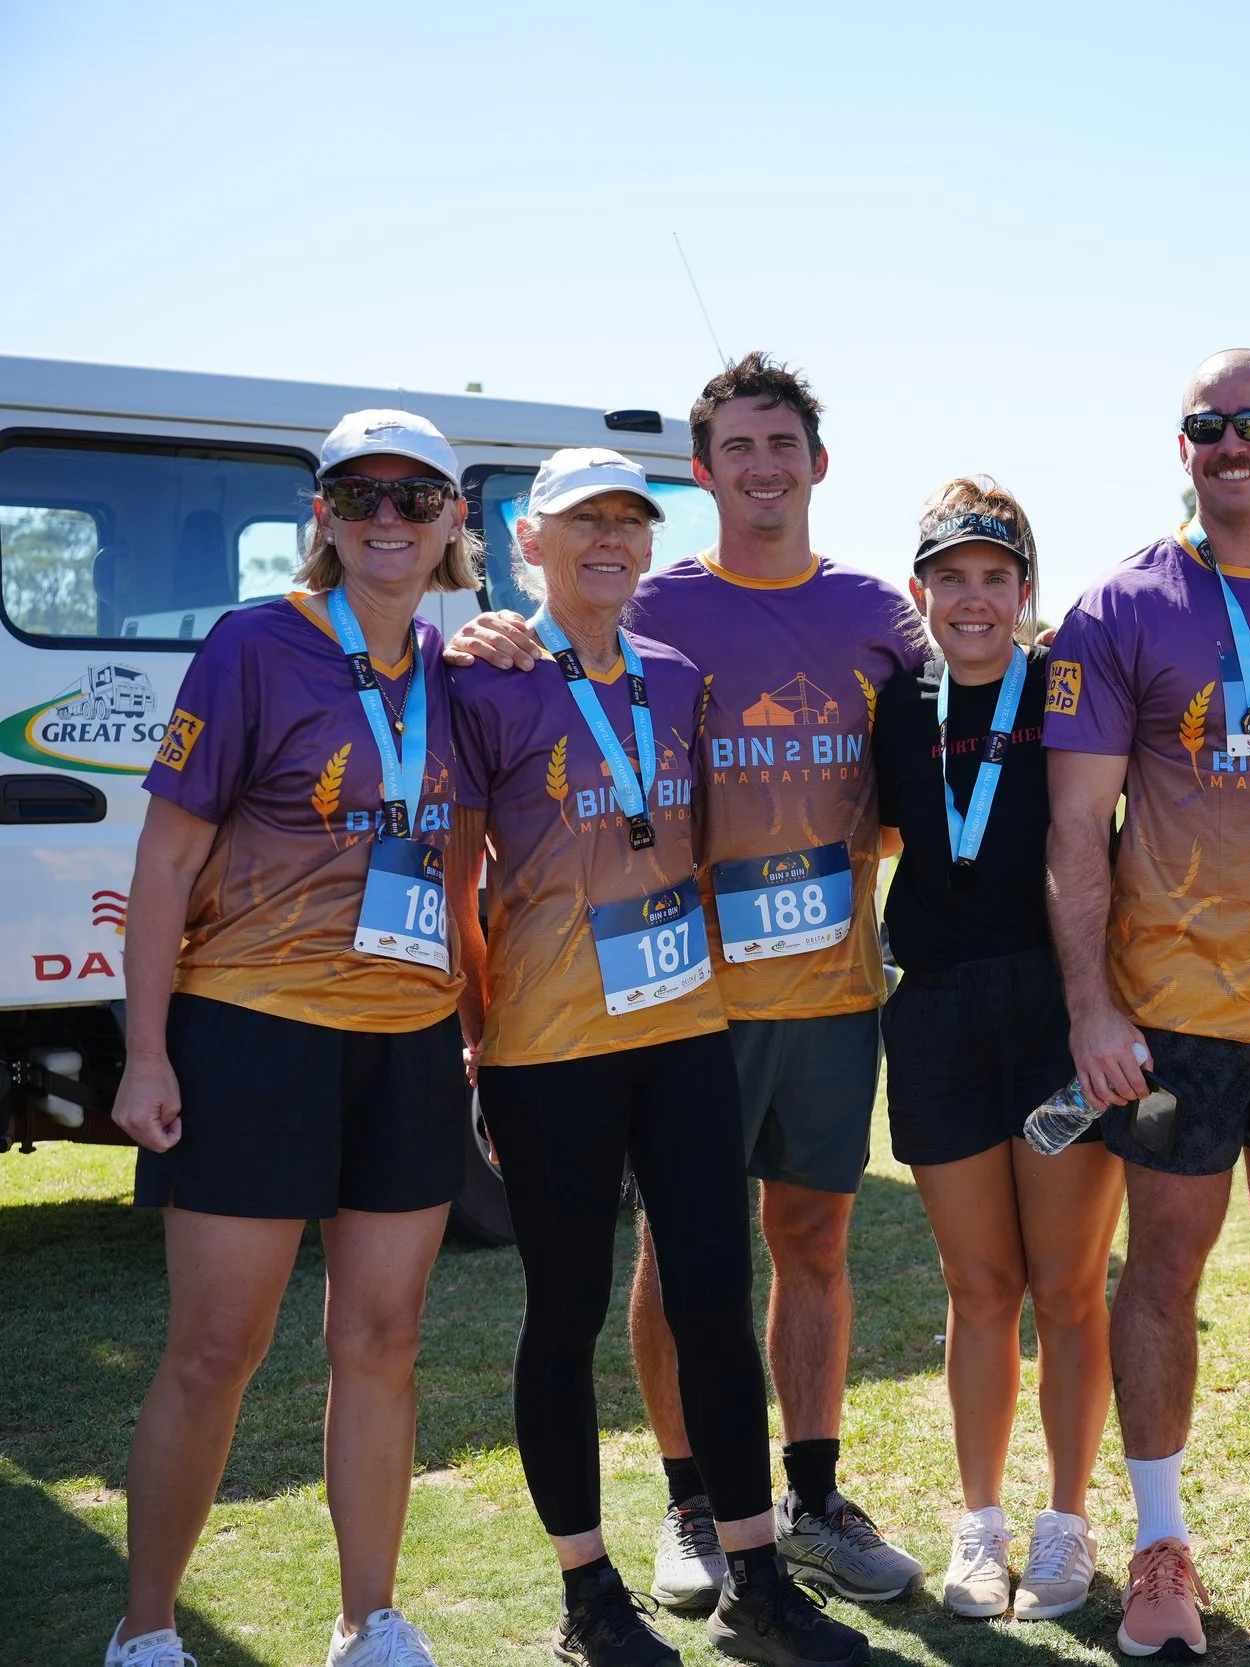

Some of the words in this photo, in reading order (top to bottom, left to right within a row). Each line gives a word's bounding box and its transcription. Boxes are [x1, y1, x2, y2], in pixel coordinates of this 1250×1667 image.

[936, 516, 964, 535] BIN
[968, 515, 977, 524] 2
[982, 516, 1008, 536] BIN
[344, 625, 359, 650] TEAM
[1046, 692, 1074, 710] elp
[998, 706, 1010, 729] TEAM
[42, 723, 126, 743] GREAT
[595, 720, 611, 742] TEAM
[639, 711, 650, 774] HALF-MARATHON
[1011, 728, 1043, 744] HE
[367, 695, 395, 771] HALF-MARATHON
[388, 771, 399, 797] TEAM
[712, 737, 774, 768] BIN
[785, 741, 801, 761] 2
[812, 734, 863, 764] BIN
[608, 742, 638, 810] HALF-MARATHON
[713, 767, 860, 785] MARATHON
[970, 768, 993, 831] HALF-MARATHON
[580, 809, 691, 833] MARTHO
[965, 832, 977, 856] TEAM
[769, 871, 784, 881] BIN
[790, 868, 805, 877] BIN
[405, 885, 446, 940] 186
[649, 911, 662, 922] BIN
[667, 906, 678, 916] BIN
[754, 884, 827, 933] 188
[637, 922, 689, 978] 187
[805, 936, 826, 944] DELTA
[31, 951, 125, 982] DA
